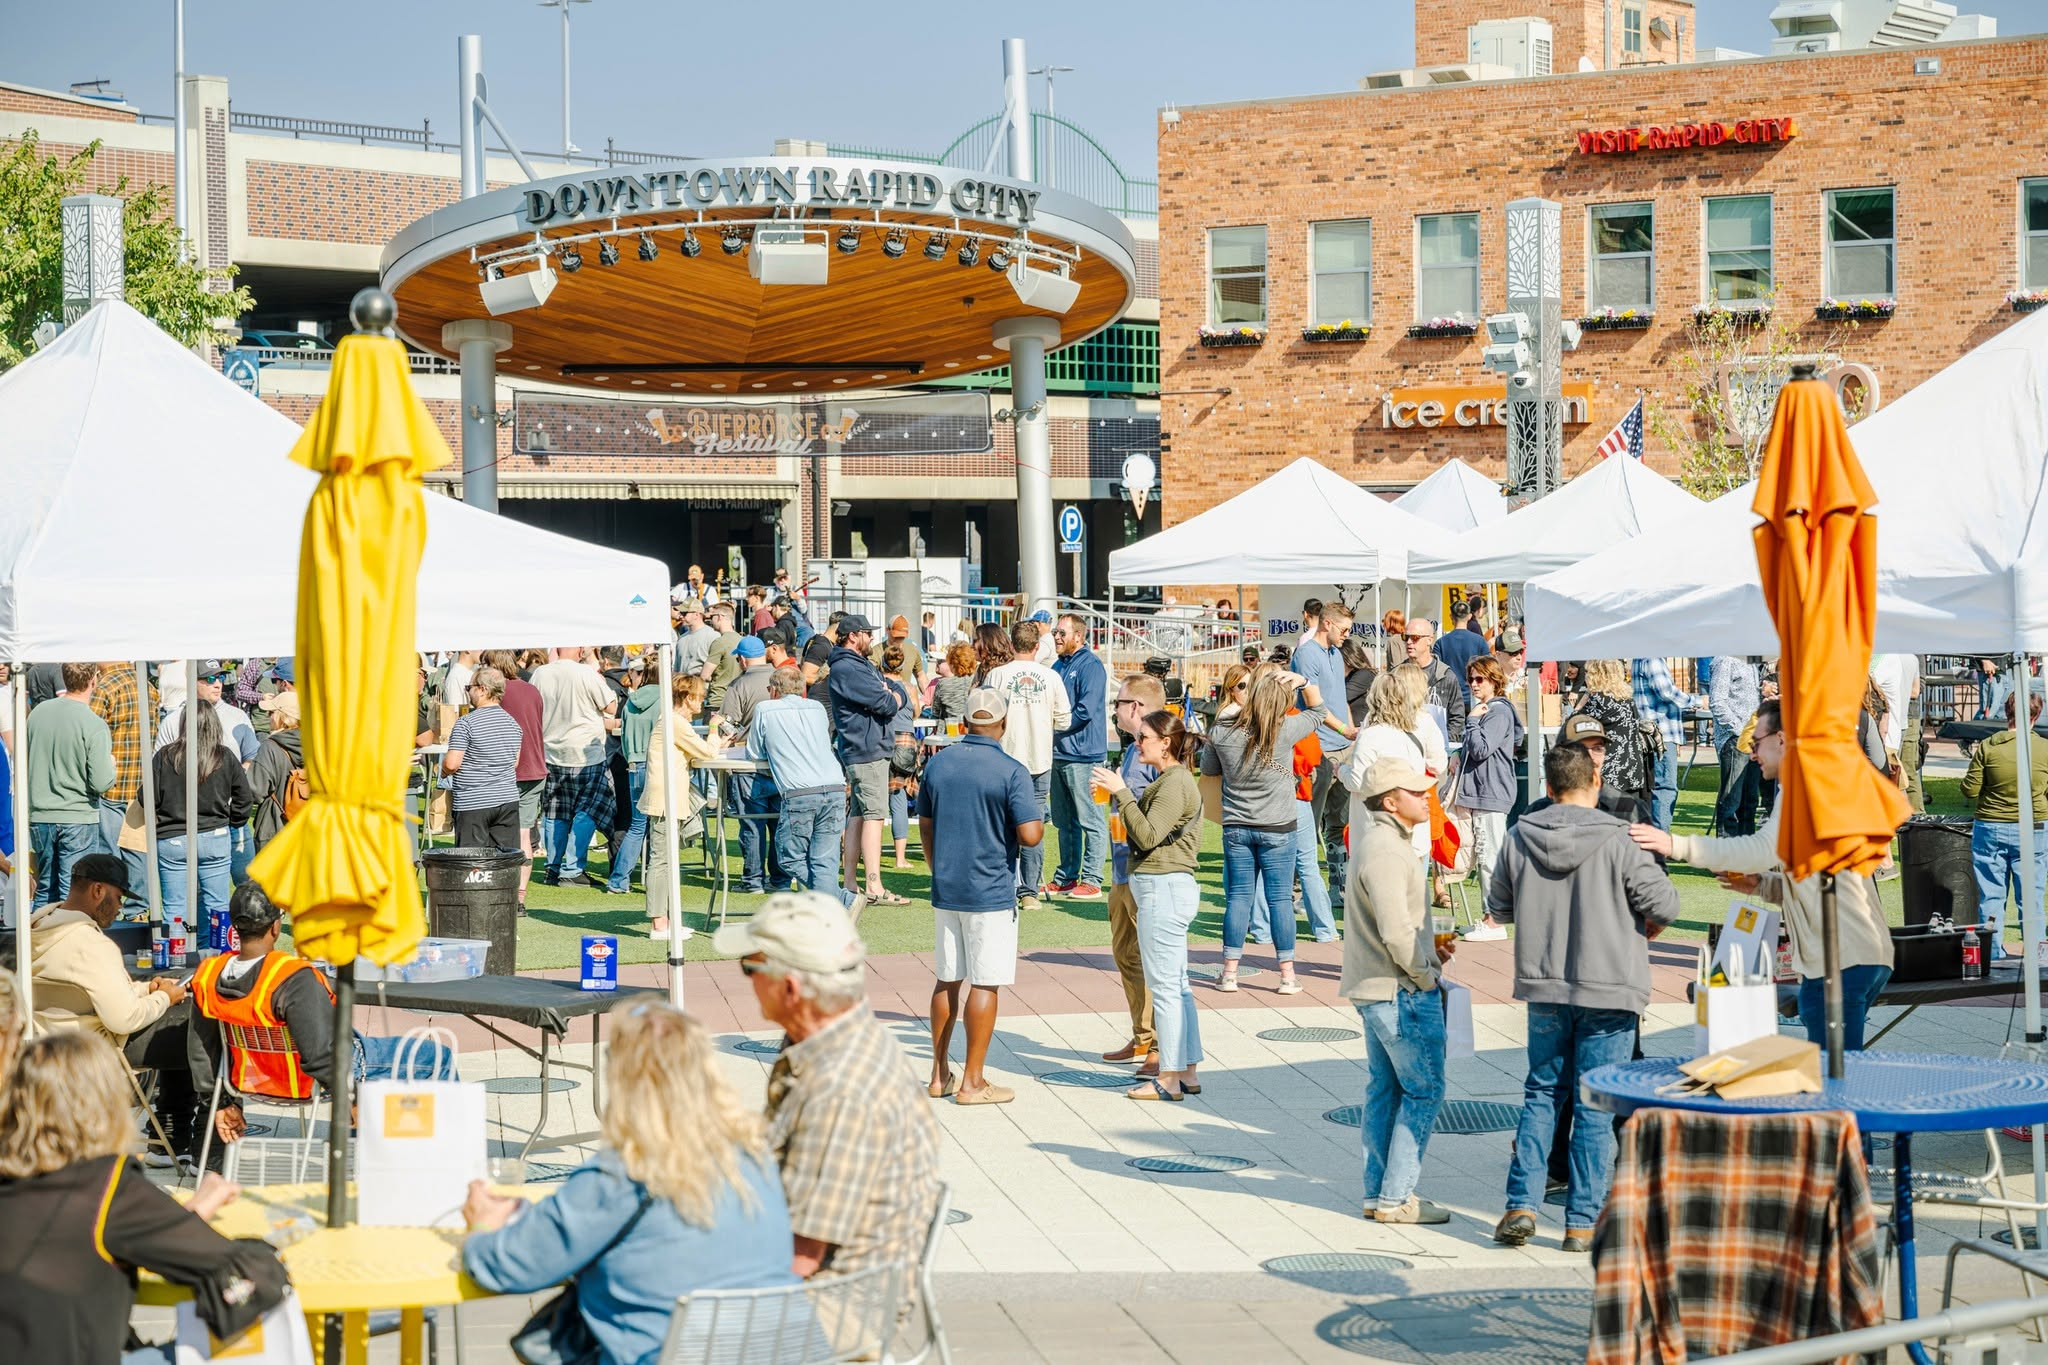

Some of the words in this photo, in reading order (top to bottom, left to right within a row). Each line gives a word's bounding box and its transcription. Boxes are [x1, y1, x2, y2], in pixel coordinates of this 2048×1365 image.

[1576, 128, 1642, 154] VISIT
[1648, 122, 1727, 150] RAPID
[1734, 117, 1792, 143] CITY
[523, 166, 799, 223] DOWNTOWN
[811, 166, 944, 206] RAPID
[951, 178, 1042, 222] CITY
[1382, 391, 1446, 429] ice
[1455, 396, 1588, 427] crem
[687, 408, 819, 442] BIERBÖRSE
[694, 433, 813, 457] Festival
[687, 499, 722, 509] PUBLIC
[725, 499, 766, 509] PARKIN
[1066, 512, 1079, 539] P
[1268, 618, 1300, 637] BIG
[1007, 671, 1027, 690] BLACK
[464, 868, 493, 884] ACE
